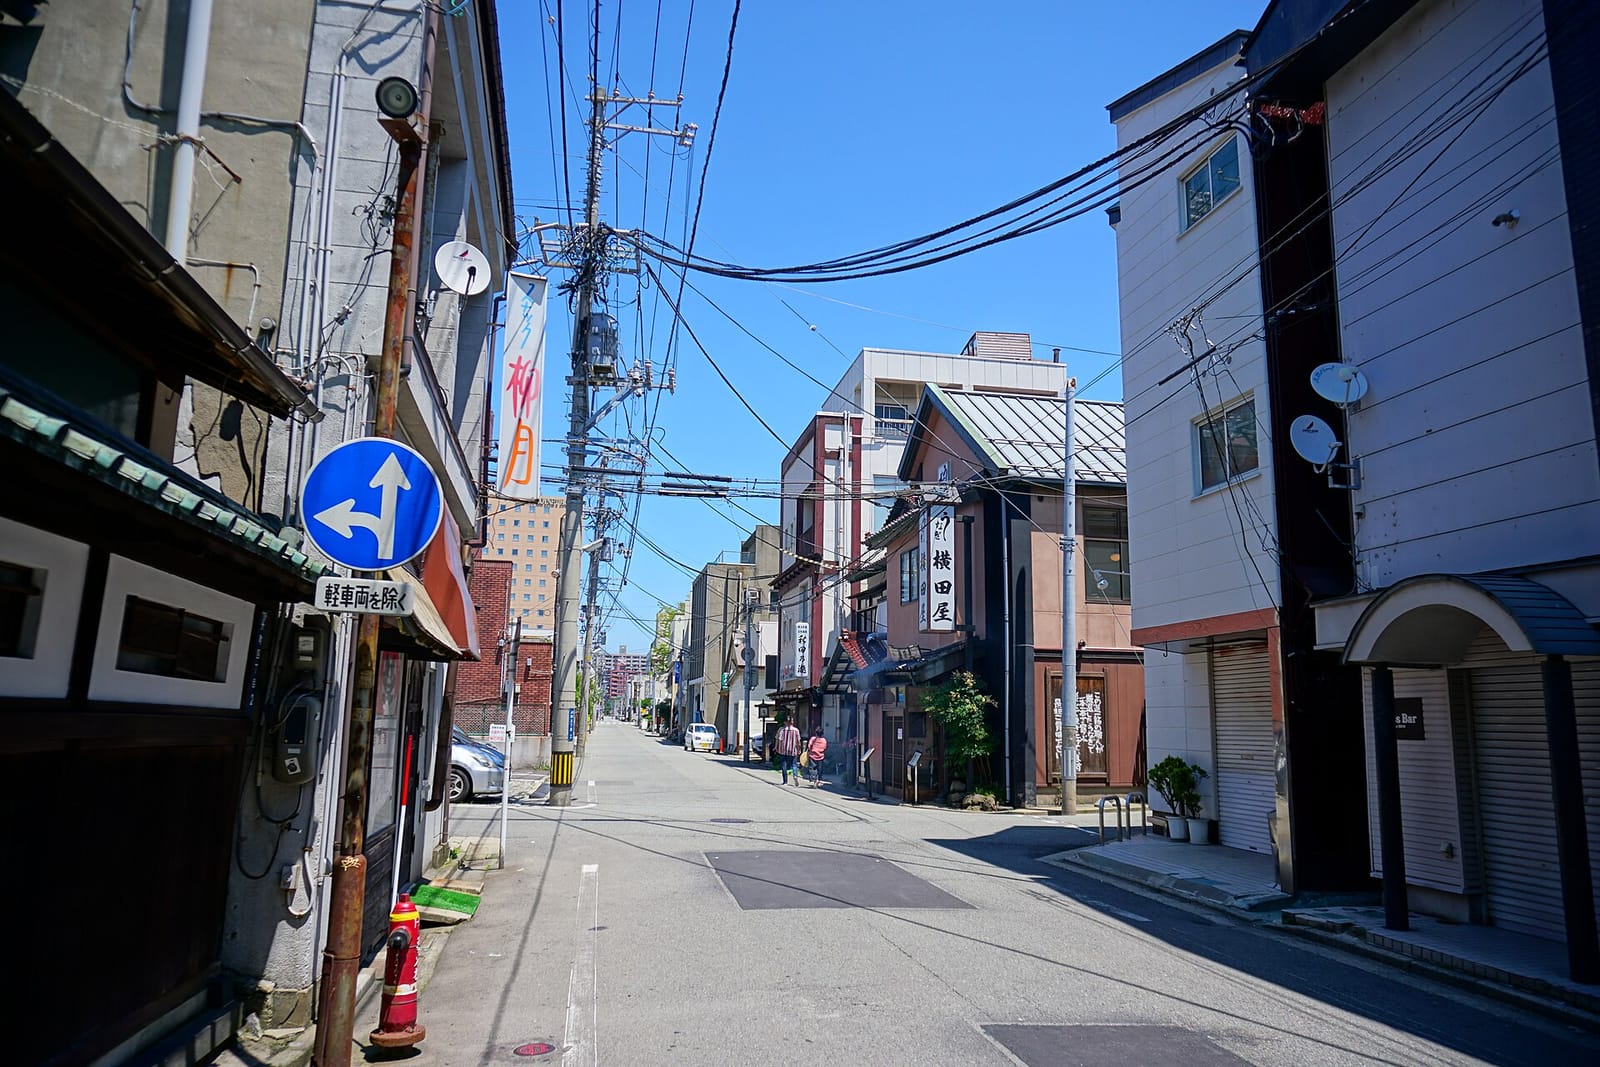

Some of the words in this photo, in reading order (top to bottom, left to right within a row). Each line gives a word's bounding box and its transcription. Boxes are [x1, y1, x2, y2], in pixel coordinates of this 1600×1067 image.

[503, 355, 540, 489] 柳月
[934, 511, 950, 541] うなぎ
[323, 583, 406, 612] 軽車両を除く
[932, 549, 953, 623] 横田屋
[1401, 712, 1417, 724] Bar
